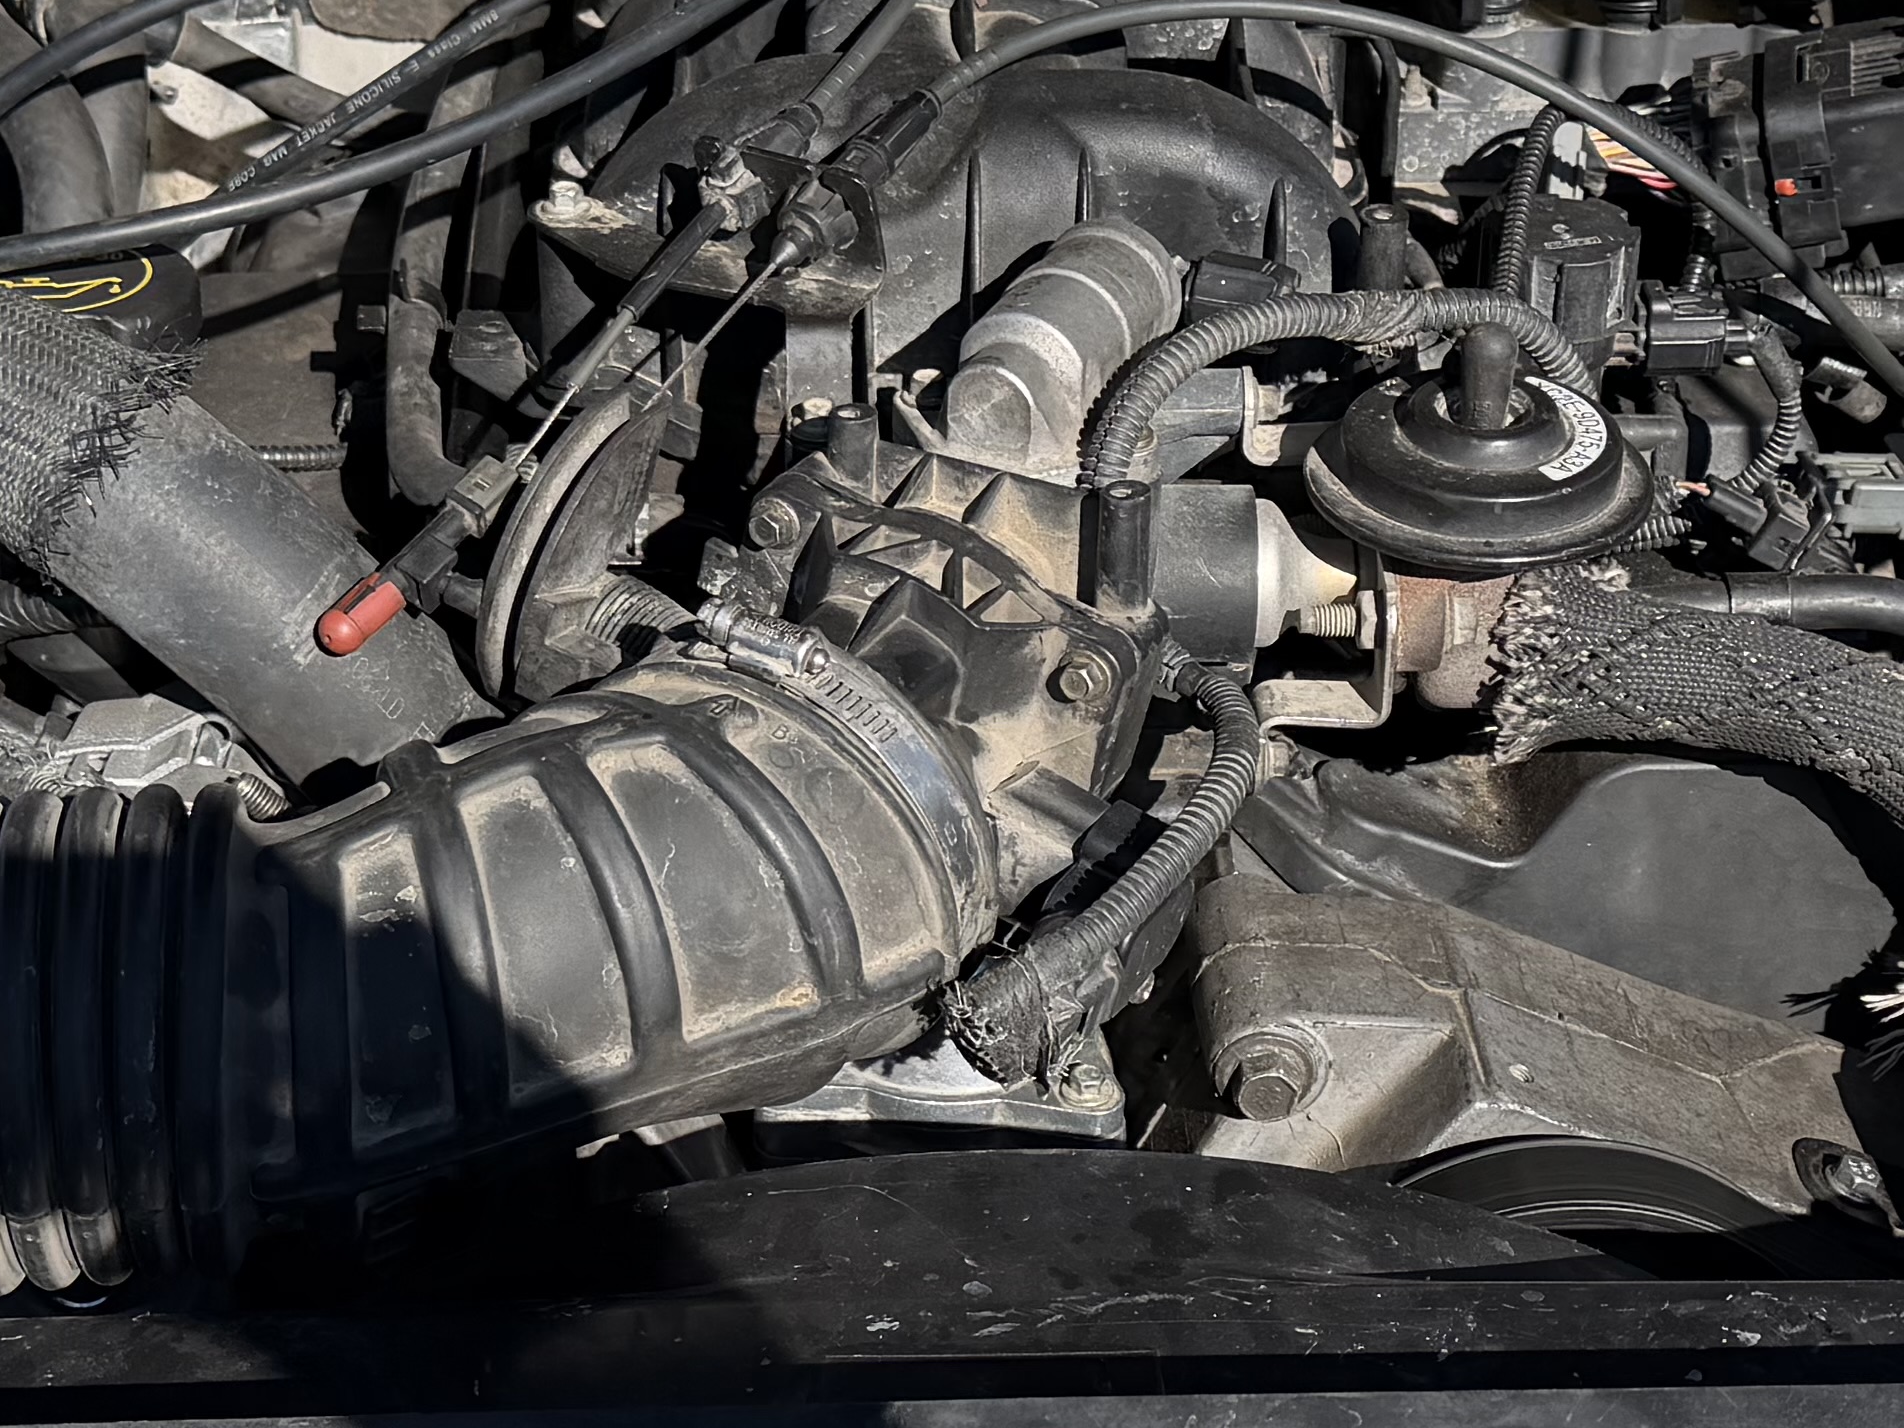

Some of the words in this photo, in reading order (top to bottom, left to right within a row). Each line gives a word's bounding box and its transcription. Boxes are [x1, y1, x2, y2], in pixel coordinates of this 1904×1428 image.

[428, 34, 460, 58] Class
[407, 60, 420, 72] E
[347, 72, 401, 114] SILICONE
[296, 112, 336, 146] JACKET
[264, 148, 288, 166] MAG
